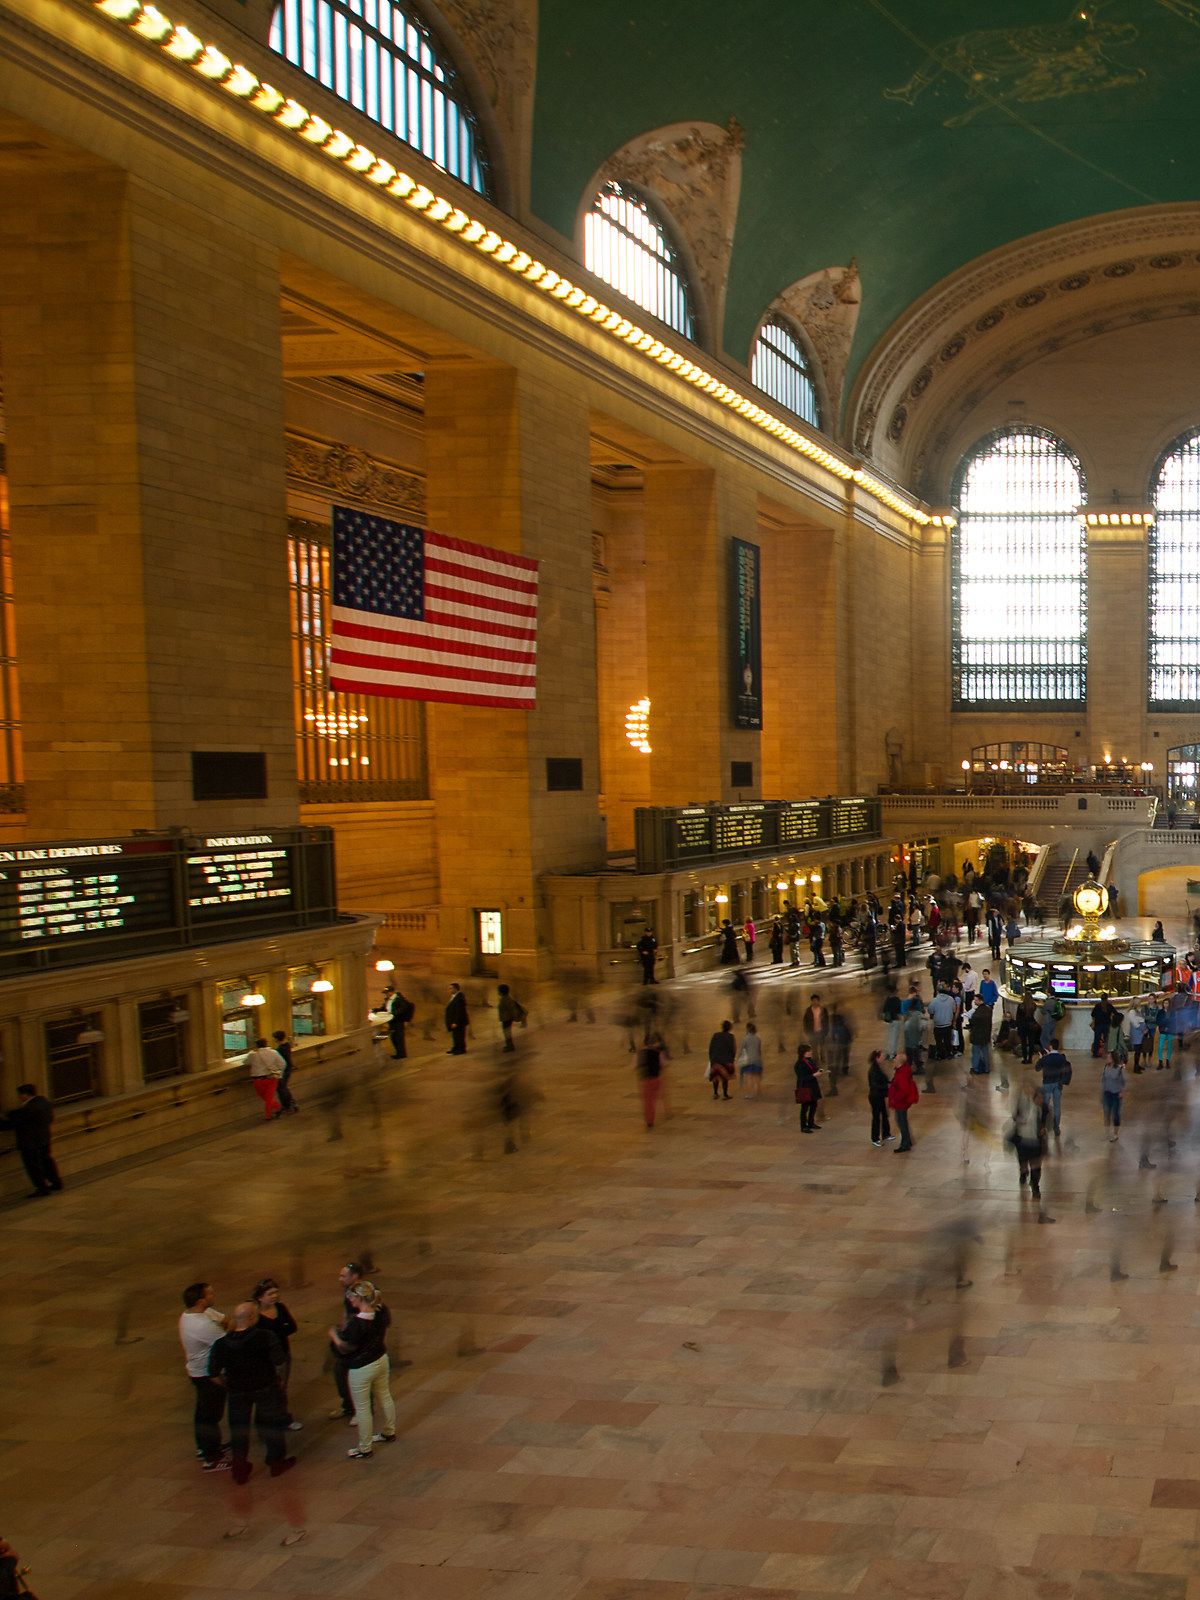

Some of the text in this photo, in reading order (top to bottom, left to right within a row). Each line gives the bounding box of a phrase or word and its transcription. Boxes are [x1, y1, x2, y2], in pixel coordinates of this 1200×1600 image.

[205, 835, 273, 847] INFORMATION
[16, 849, 48, 860] LINE
[48, 845, 123, 858] DEPARTURES
[20, 867, 69, 878] REMARKS
